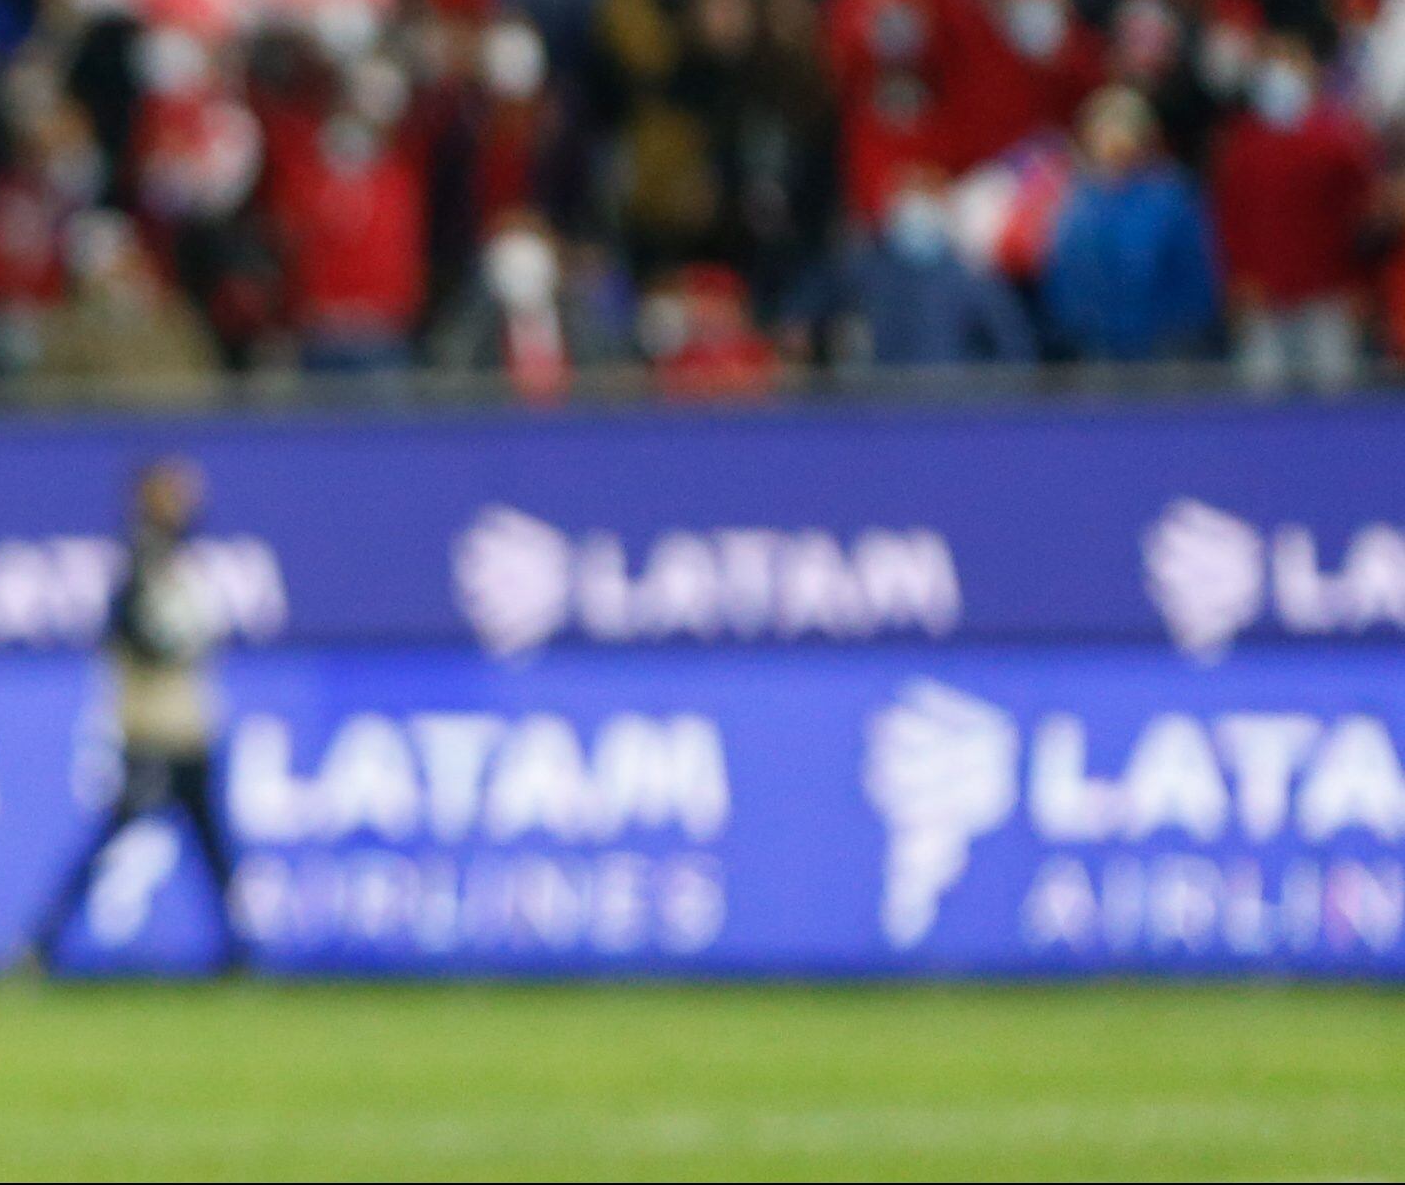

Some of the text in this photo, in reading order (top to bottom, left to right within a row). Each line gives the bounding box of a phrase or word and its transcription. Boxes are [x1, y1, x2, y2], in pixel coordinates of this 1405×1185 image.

[577, 527, 964, 642] LATAM
[224, 710, 731, 845] LATAM
[1029, 710, 1405, 845] LATA
